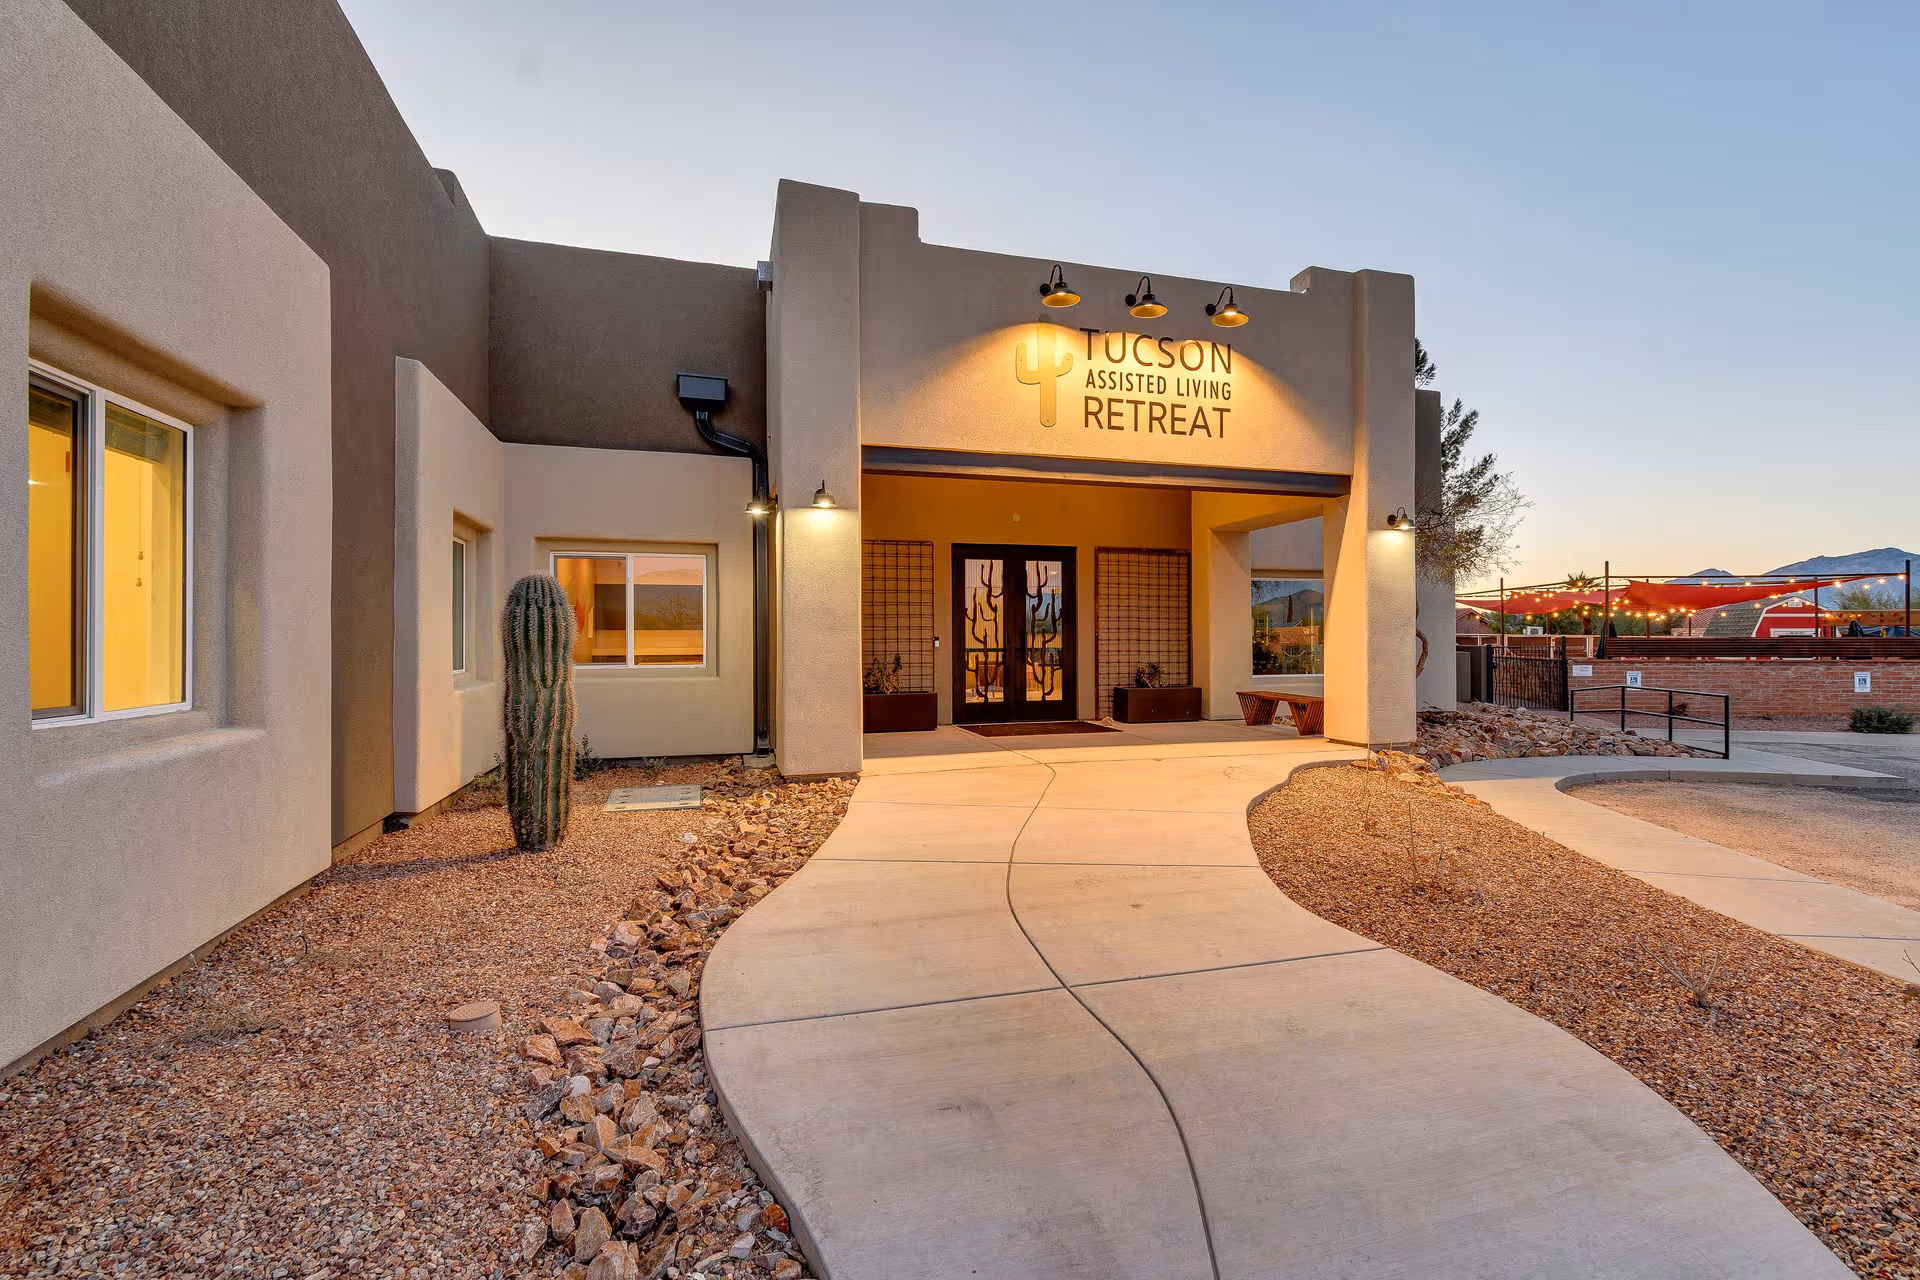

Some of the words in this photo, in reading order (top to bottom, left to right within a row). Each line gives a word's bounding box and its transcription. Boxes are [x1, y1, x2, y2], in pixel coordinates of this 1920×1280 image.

[1079, 327, 1232, 374] TUCSON
[1085, 368, 1167, 395] ASSISTED
[1176, 377, 1232, 401] LIVING
[1084, 395, 1232, 439] RETREAT
